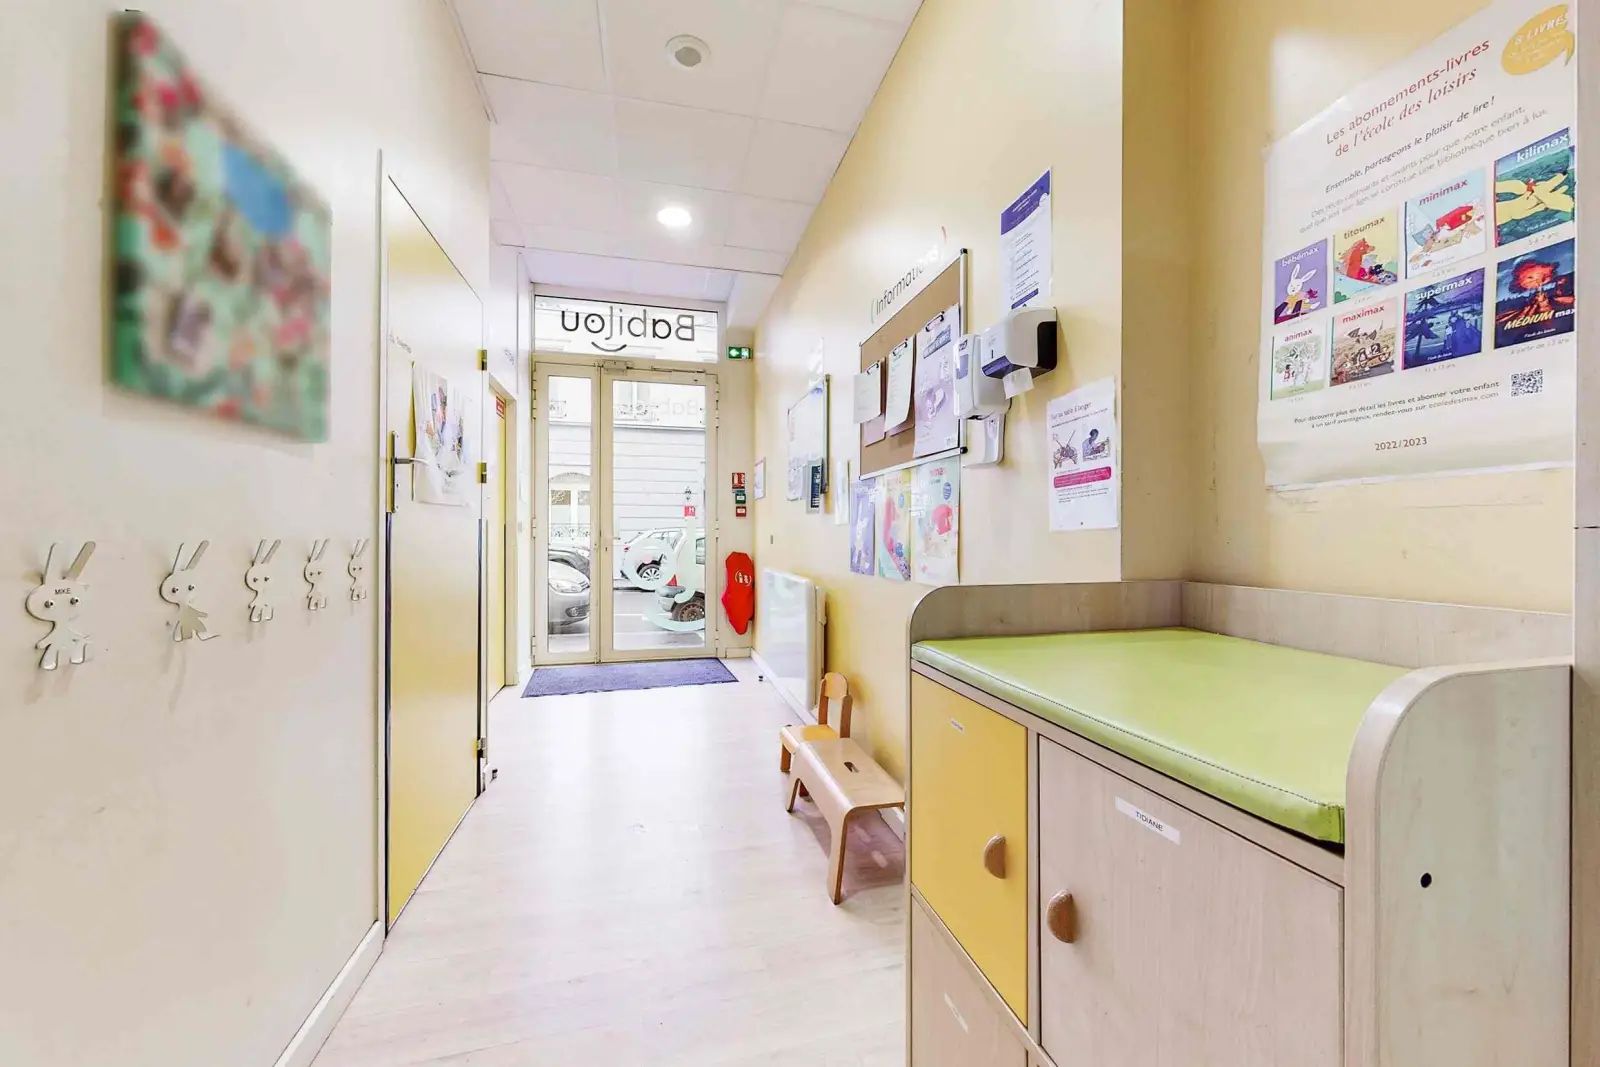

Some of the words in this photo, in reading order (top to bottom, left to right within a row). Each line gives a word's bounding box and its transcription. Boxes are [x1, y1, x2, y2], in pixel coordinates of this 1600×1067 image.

[1527, 12, 1569, 39] LIVRES
[1326, 128, 1345, 145] Les
[1349, 39, 1491, 131] abonnements-livres
[1335, 143, 1349, 157] de
[1353, 113, 1395, 147] l'école
[1399, 99, 1422, 121] des
[1428, 68, 1477, 104] loisirs
[1420, 148, 1441, 165] pour
[1442, 139, 1460, 152] que
[1463, 125, 1489, 141] votre
[1490, 105, 1526, 127] enfant,
[1497, 122, 1520, 137] bien
[1325, 169, 1364, 193] Ensemble,
[1364, 142, 1412, 175] partageons
[1414, 136, 1423, 146] le
[1425, 119, 1455, 142] plaisir
[1457, 110, 1470, 123] de
[1516, 133, 1571, 163] kilimax
[1419, 178, 1469, 207] minimax
[1343, 216, 1385, 240] titoumax
[1281, 246, 1320, 268] bébémax
[1414, 276, 1473, 302] supermax
[1342, 305, 1385, 324] maximax
[1284, 328, 1313, 343] animax
[1358, 403, 1376, 413] détail
[1387, 398, 1406, 407] livres
[1416, 391, 1447, 402] abonner
[1449, 386, 1472, 396] votre
[1473, 381, 1501, 392] enfant
[1372, 407, 1413, 419] rendez-vous
[1414, 404, 1428, 412] sur
[1428, 391, 1500, 409] ecoledesmax.com
[1374, 436, 1428, 452] 2022/2023
[54, 587, 71, 595] MIKE
[1135, 810, 1164, 832] TIDIANE
